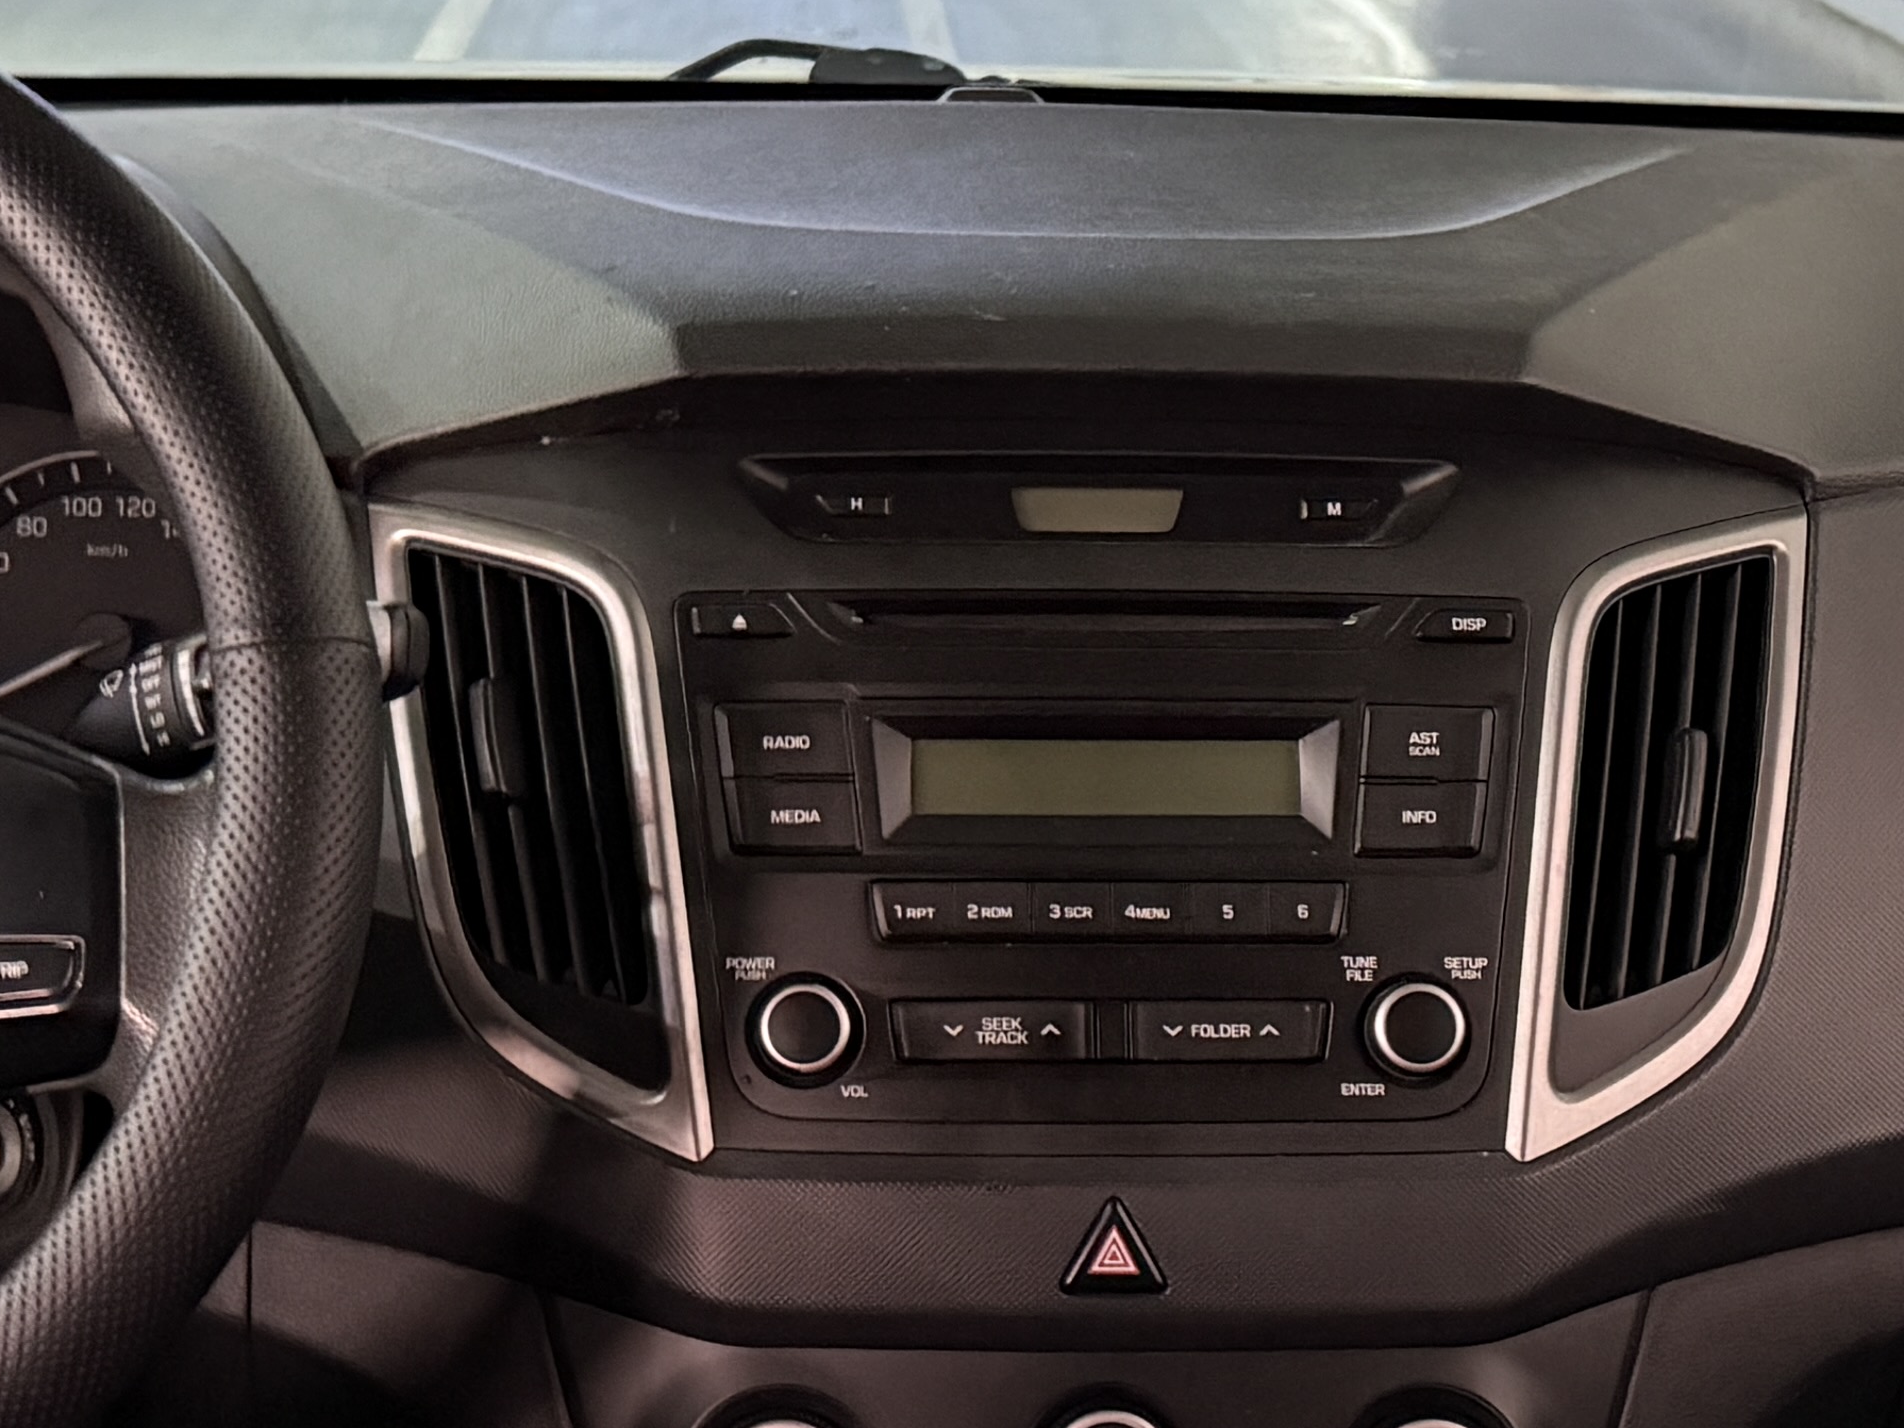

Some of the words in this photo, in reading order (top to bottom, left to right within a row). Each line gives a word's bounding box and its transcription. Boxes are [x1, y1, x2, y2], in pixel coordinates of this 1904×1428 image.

[61, 496, 103, 518] 100
[116, 496, 157, 518] 120
[16, 516, 48, 538] 80
[86, 542, 129, 558] km/h
[1451, 616, 1488, 633] DISP
[762, 734, 810, 751] RADIO
[1408, 731, 1440, 746] AST
[1408, 746, 1440, 757] SCAN
[770, 809, 821, 825] MEDIA
[1402, 810, 1437, 825] INFO
[1222, 904, 1234, 920] 5
[1297, 904, 1309, 920] 6
[725, 956, 776, 970] POWER
[1341, 956, 1378, 970] TUNE
[1444, 956, 1488, 971] SETUP
[1346, 969, 1373, 982] FILE
[1451, 970, 1482, 980] PUSH
[981, 1016, 1023, 1031] SEEK
[1191, 1023, 1251, 1039] FOLDER
[976, 1031, 1029, 1046] TRACK
[840, 1084, 869, 1099] VOL
[1341, 1083, 1385, 1097] ENTER
